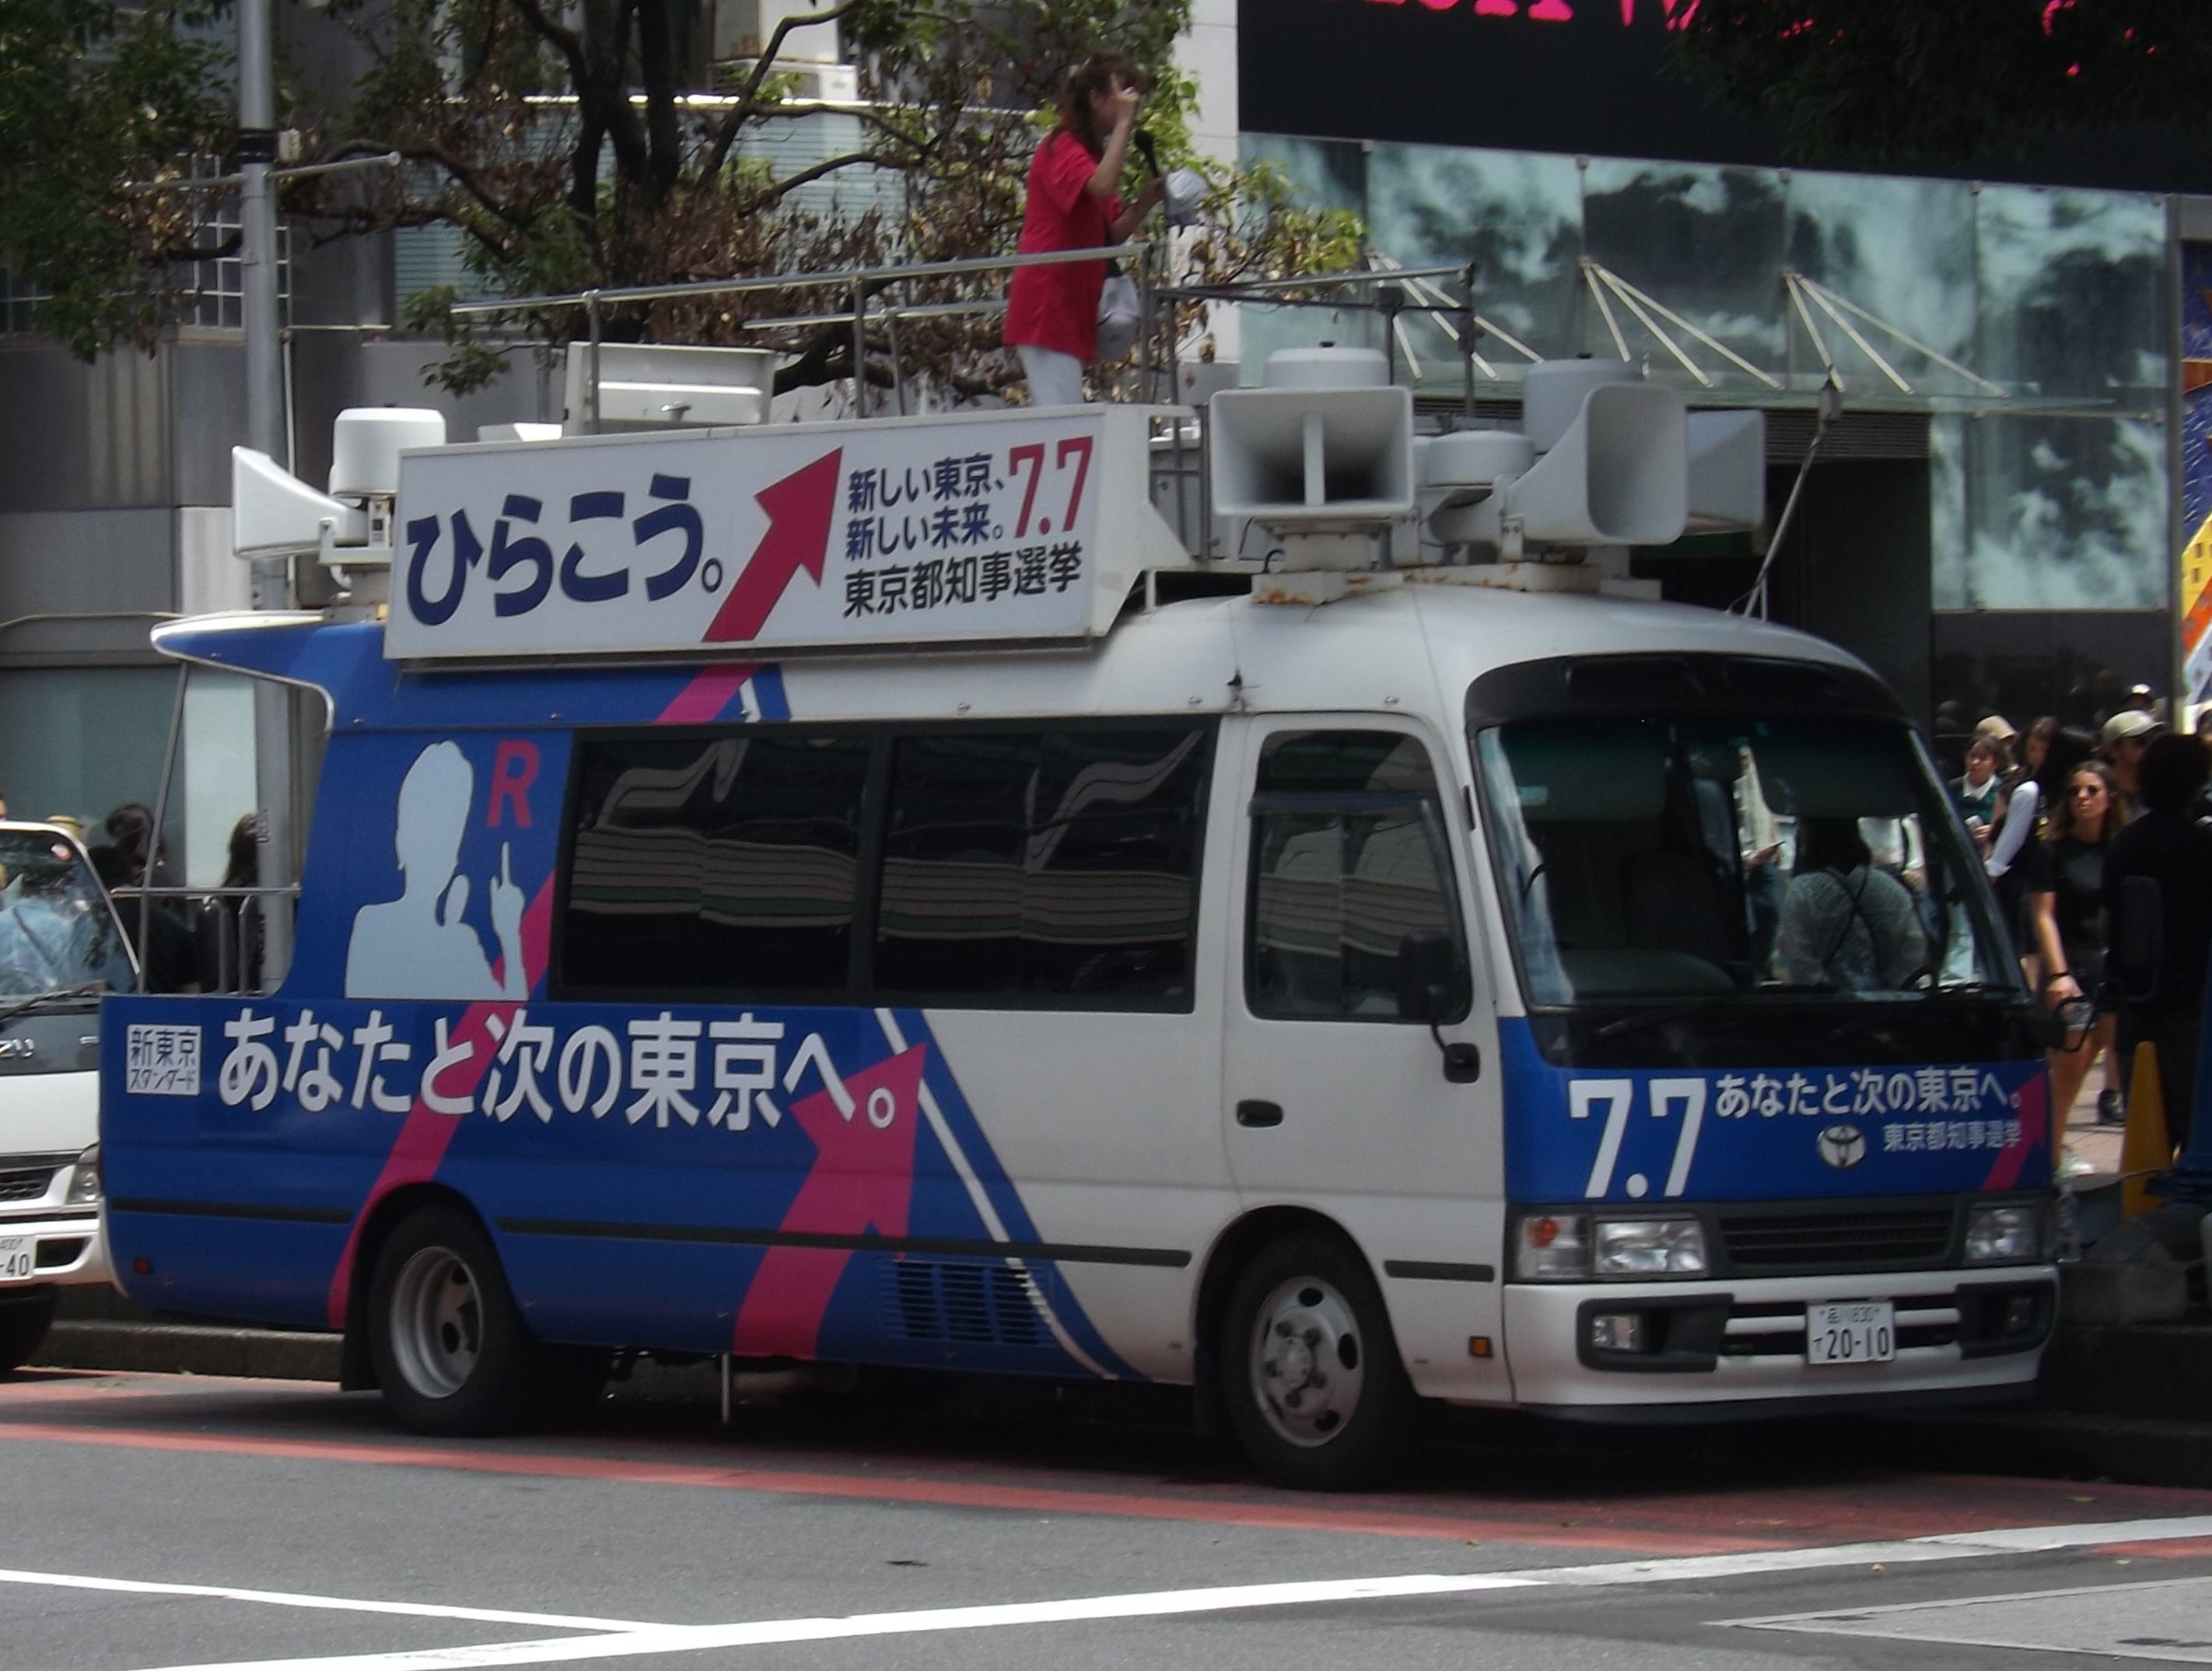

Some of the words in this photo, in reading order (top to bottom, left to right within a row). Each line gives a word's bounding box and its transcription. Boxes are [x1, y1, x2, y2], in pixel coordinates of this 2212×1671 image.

[848, 451, 1004, 513] 新しい東京、
[1008, 435, 1094, 538] 7.7
[404, 473, 723, 625] ひらこう。
[845, 501, 1004, 562] 新しい未来。
[843, 540, 1083, 618] 東京都知事選挙
[487, 739, 540, 828] R
[131, 1026, 198, 1067] 新東京
[219, 1007, 897, 1132] あなたと次の東京へ。
[1714, 1065, 2021, 1119] あなたと次の東京へ。
[1569, 1077, 1707, 1200] 7.7
[1882, 1119, 2022, 1152] 東京都知事選挙
